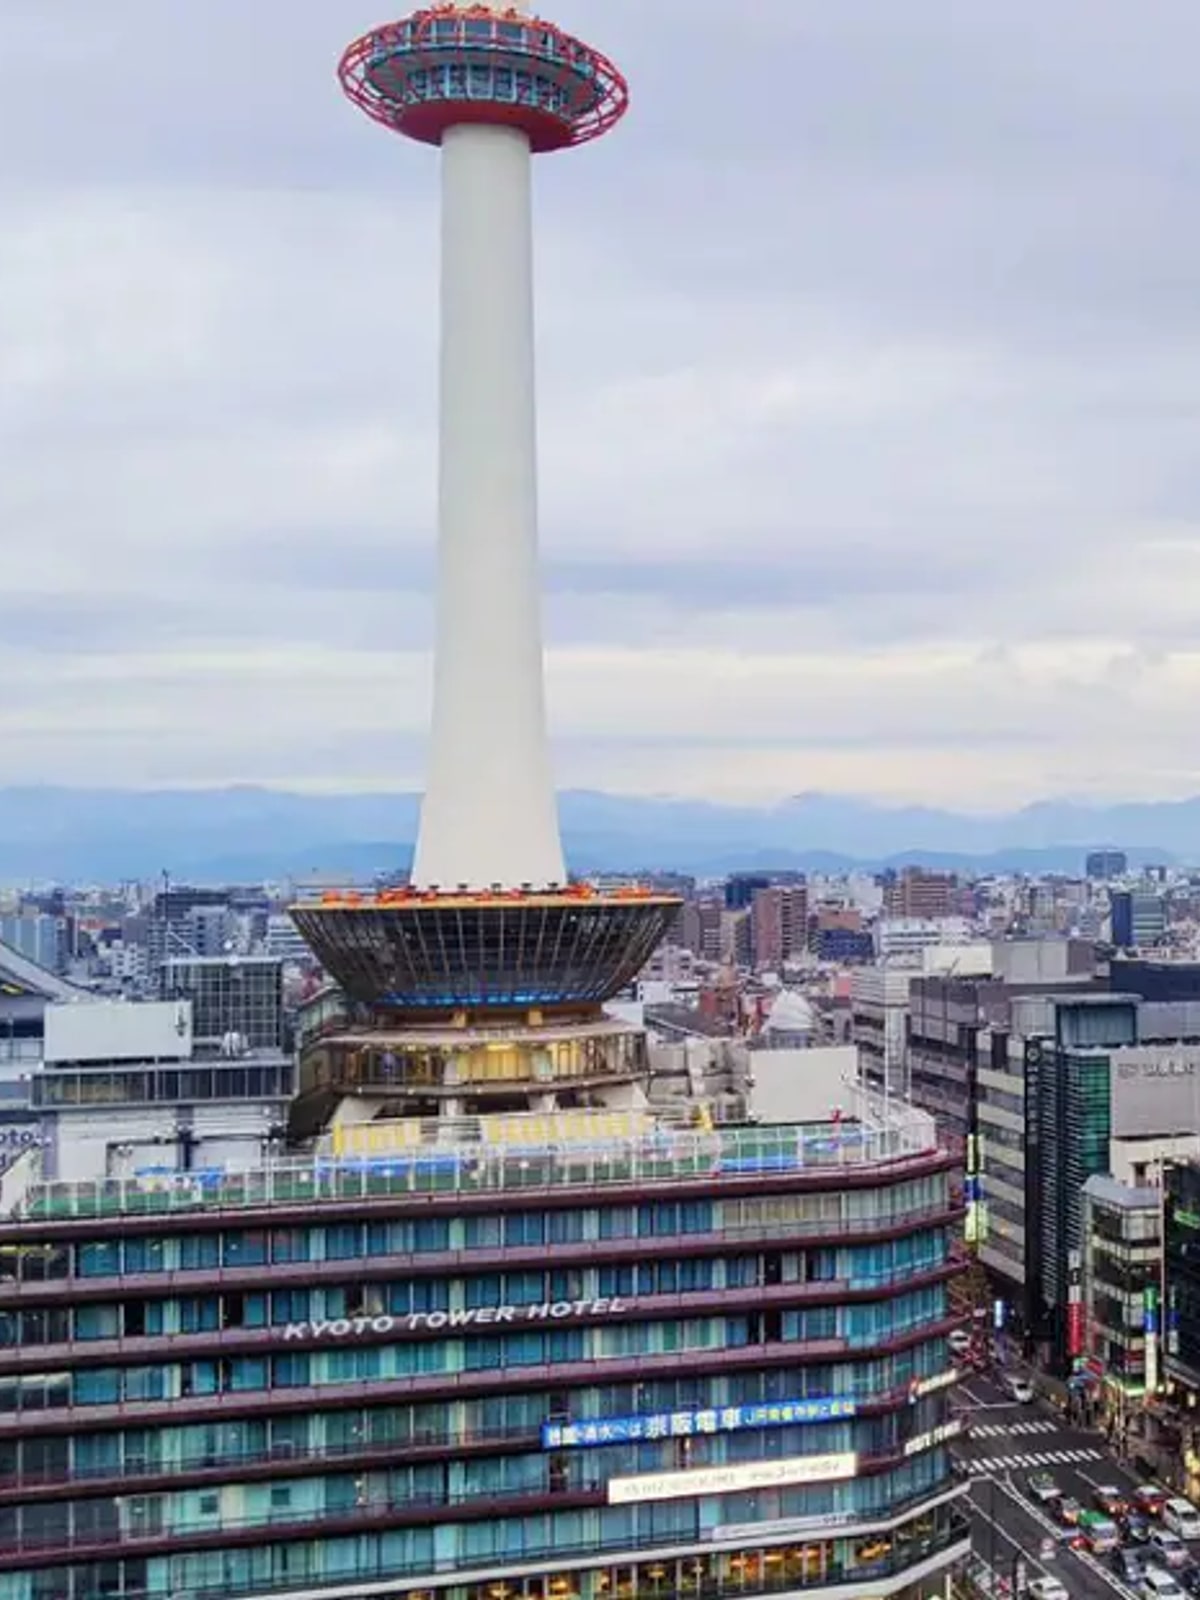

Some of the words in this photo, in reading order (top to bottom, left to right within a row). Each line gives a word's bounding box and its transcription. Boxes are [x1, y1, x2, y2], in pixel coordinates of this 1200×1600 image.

[283, 1314, 394, 1340] KYOTO
[408, 1306, 514, 1330] TOWER
[527, 1298, 627, 1319] HOTEL
[645, 1407, 741, 1440] 京阪電車
